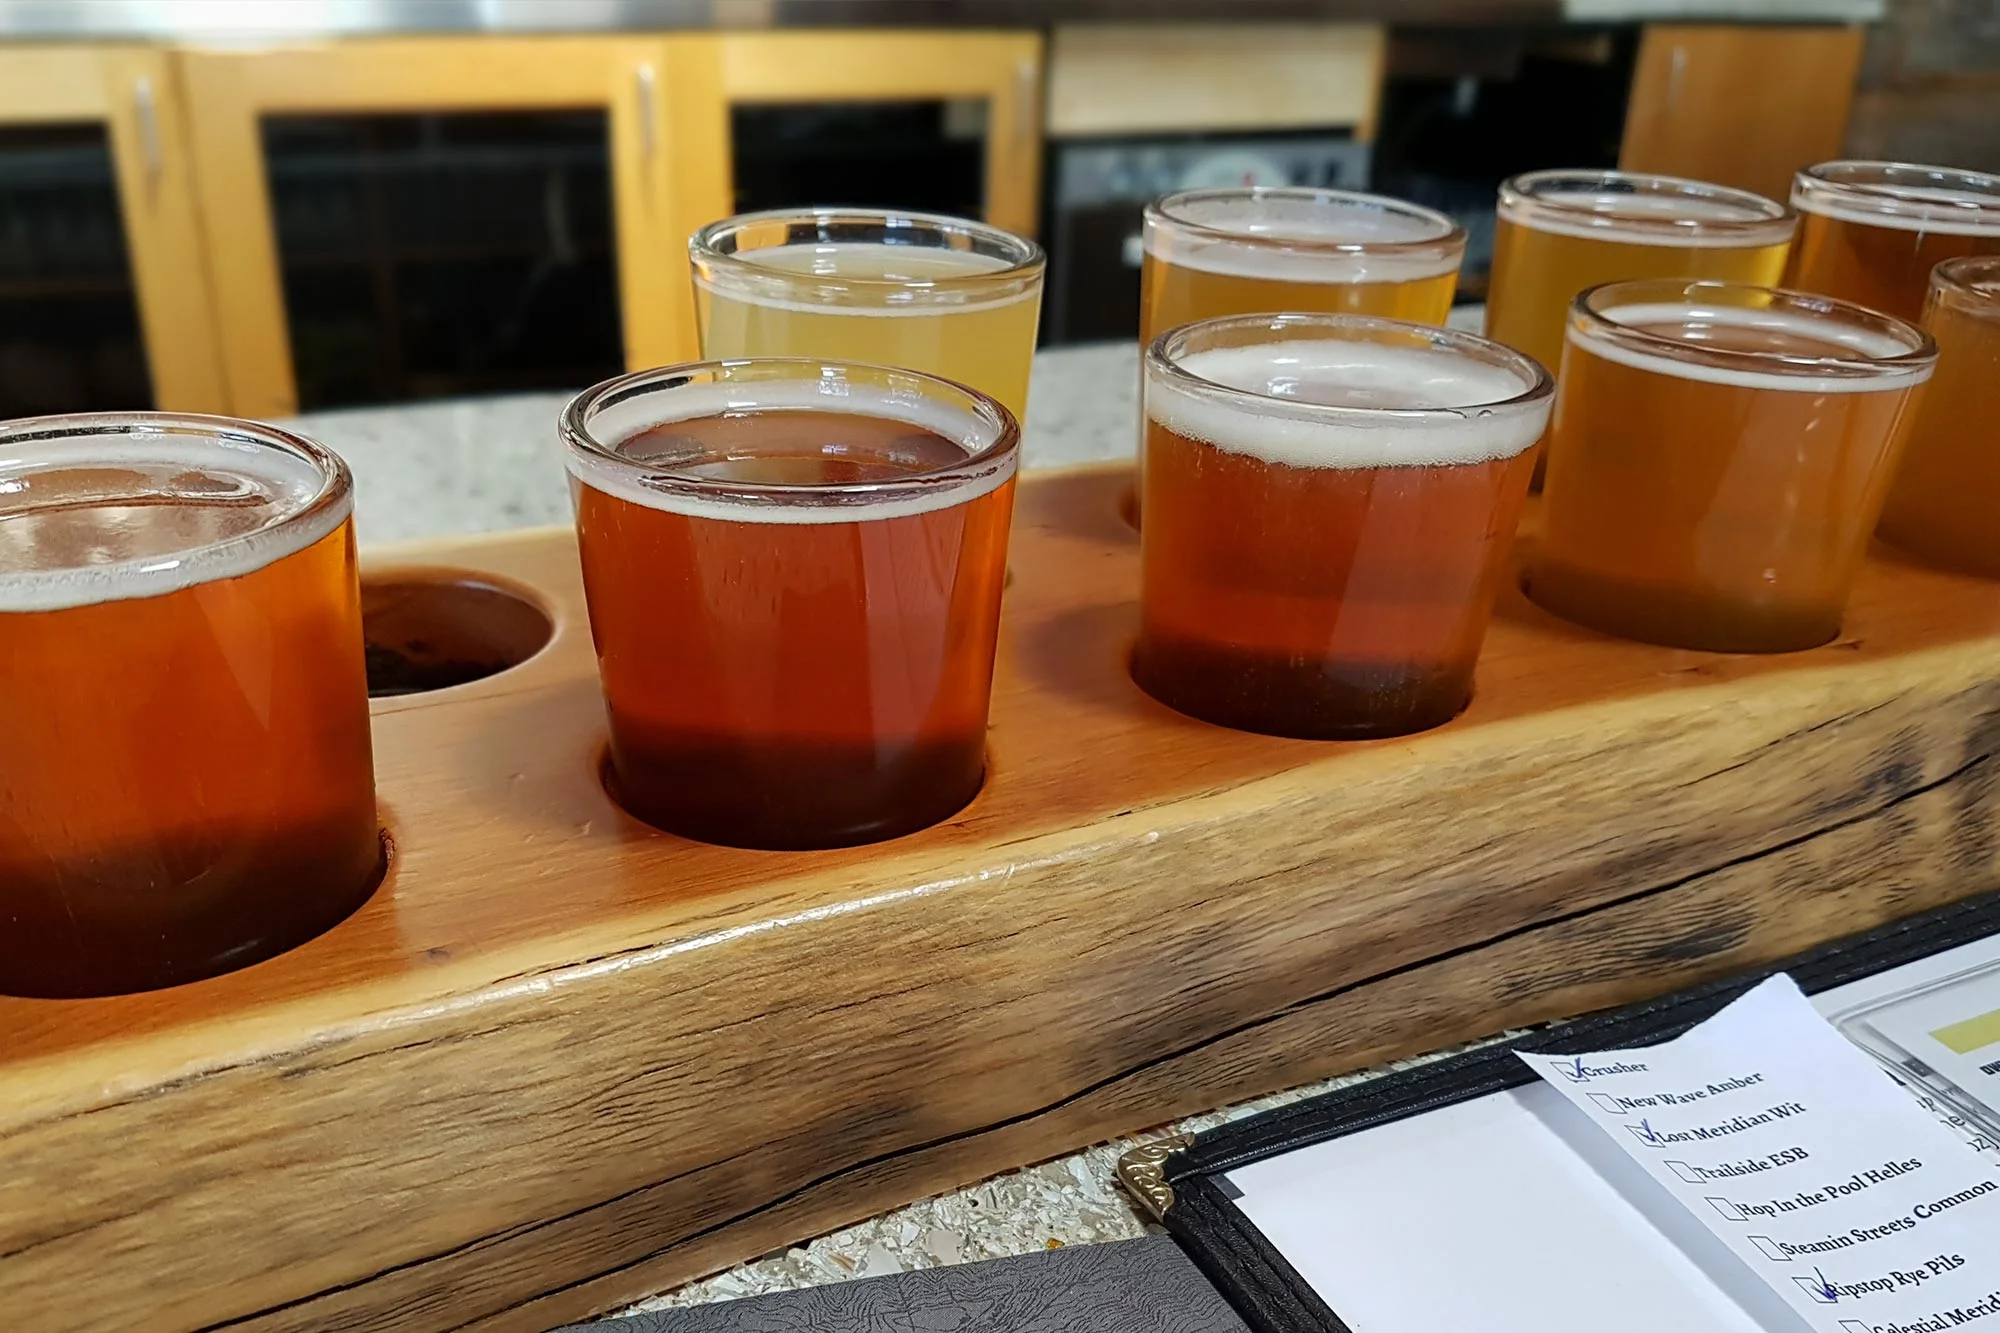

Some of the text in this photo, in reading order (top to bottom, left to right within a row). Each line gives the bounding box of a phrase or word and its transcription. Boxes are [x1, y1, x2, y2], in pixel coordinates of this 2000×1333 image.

[1581, 1062, 1648, 1078] Crusher
[1616, 1072, 1764, 1109] New Wave Amber
[1654, 1101, 1807, 1143] Lost Meridian Wit
[1693, 1146, 1809, 1179] Trailside ESB
[1735, 1157, 1923, 1218] Hop In the Pool Helles
[1779, 1180, 2000, 1256] Steamin Streets Common
[1825, 1253, 1966, 1299] Ripstop Rye Pils
[1943, 1291, 2000, 1326] Merid
